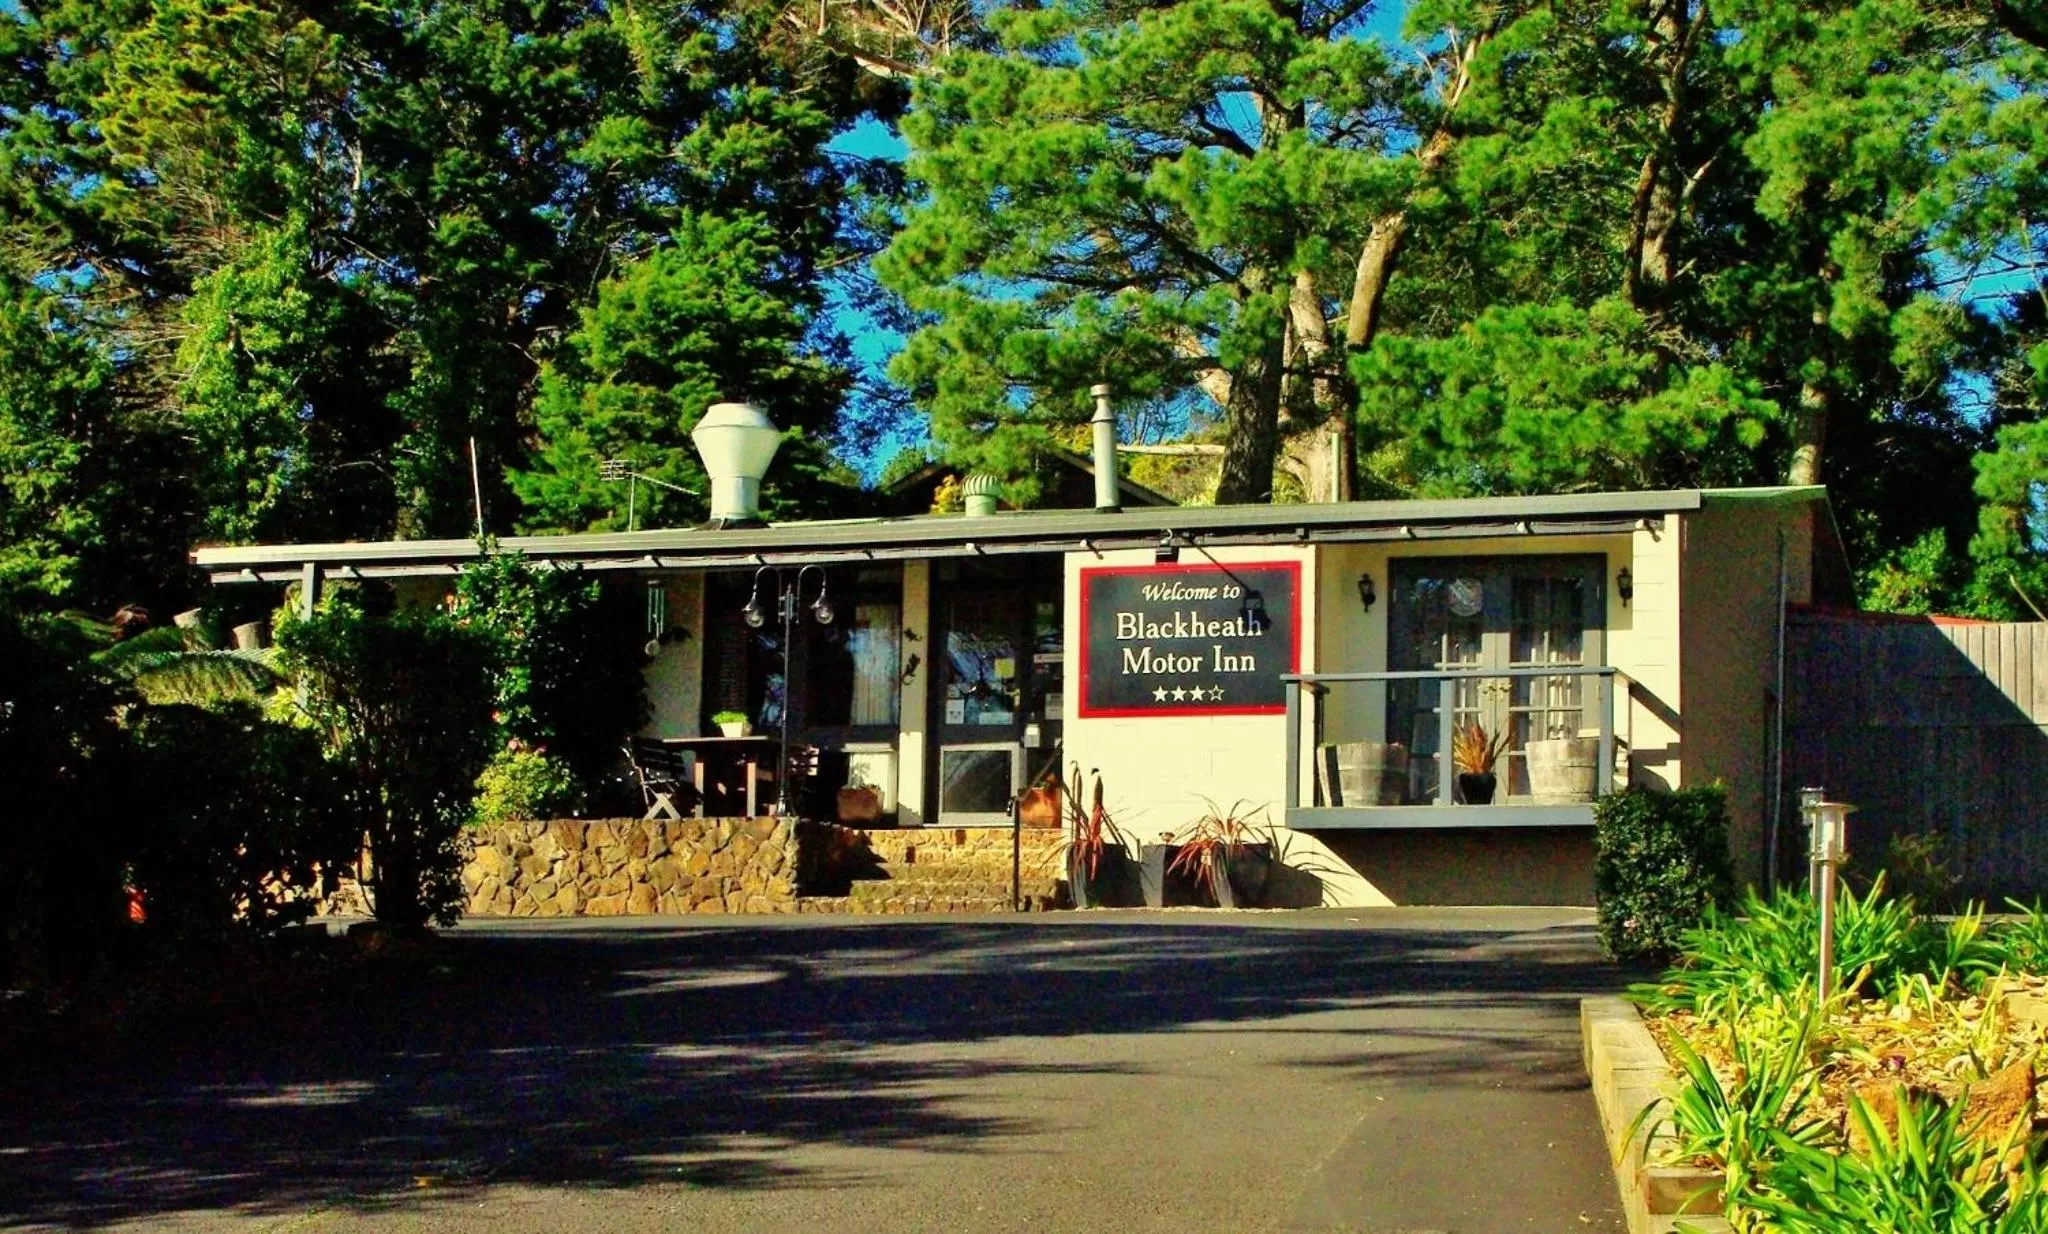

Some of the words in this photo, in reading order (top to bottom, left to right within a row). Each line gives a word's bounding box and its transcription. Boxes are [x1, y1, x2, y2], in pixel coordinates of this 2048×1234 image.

[1142, 581, 1218, 601] Welcome
[1223, 584, 1241, 599] to
[1116, 609, 1263, 640] Blackheath
[1122, 646, 1204, 675] Motor
[1213, 645, 1256, 673] Inn
